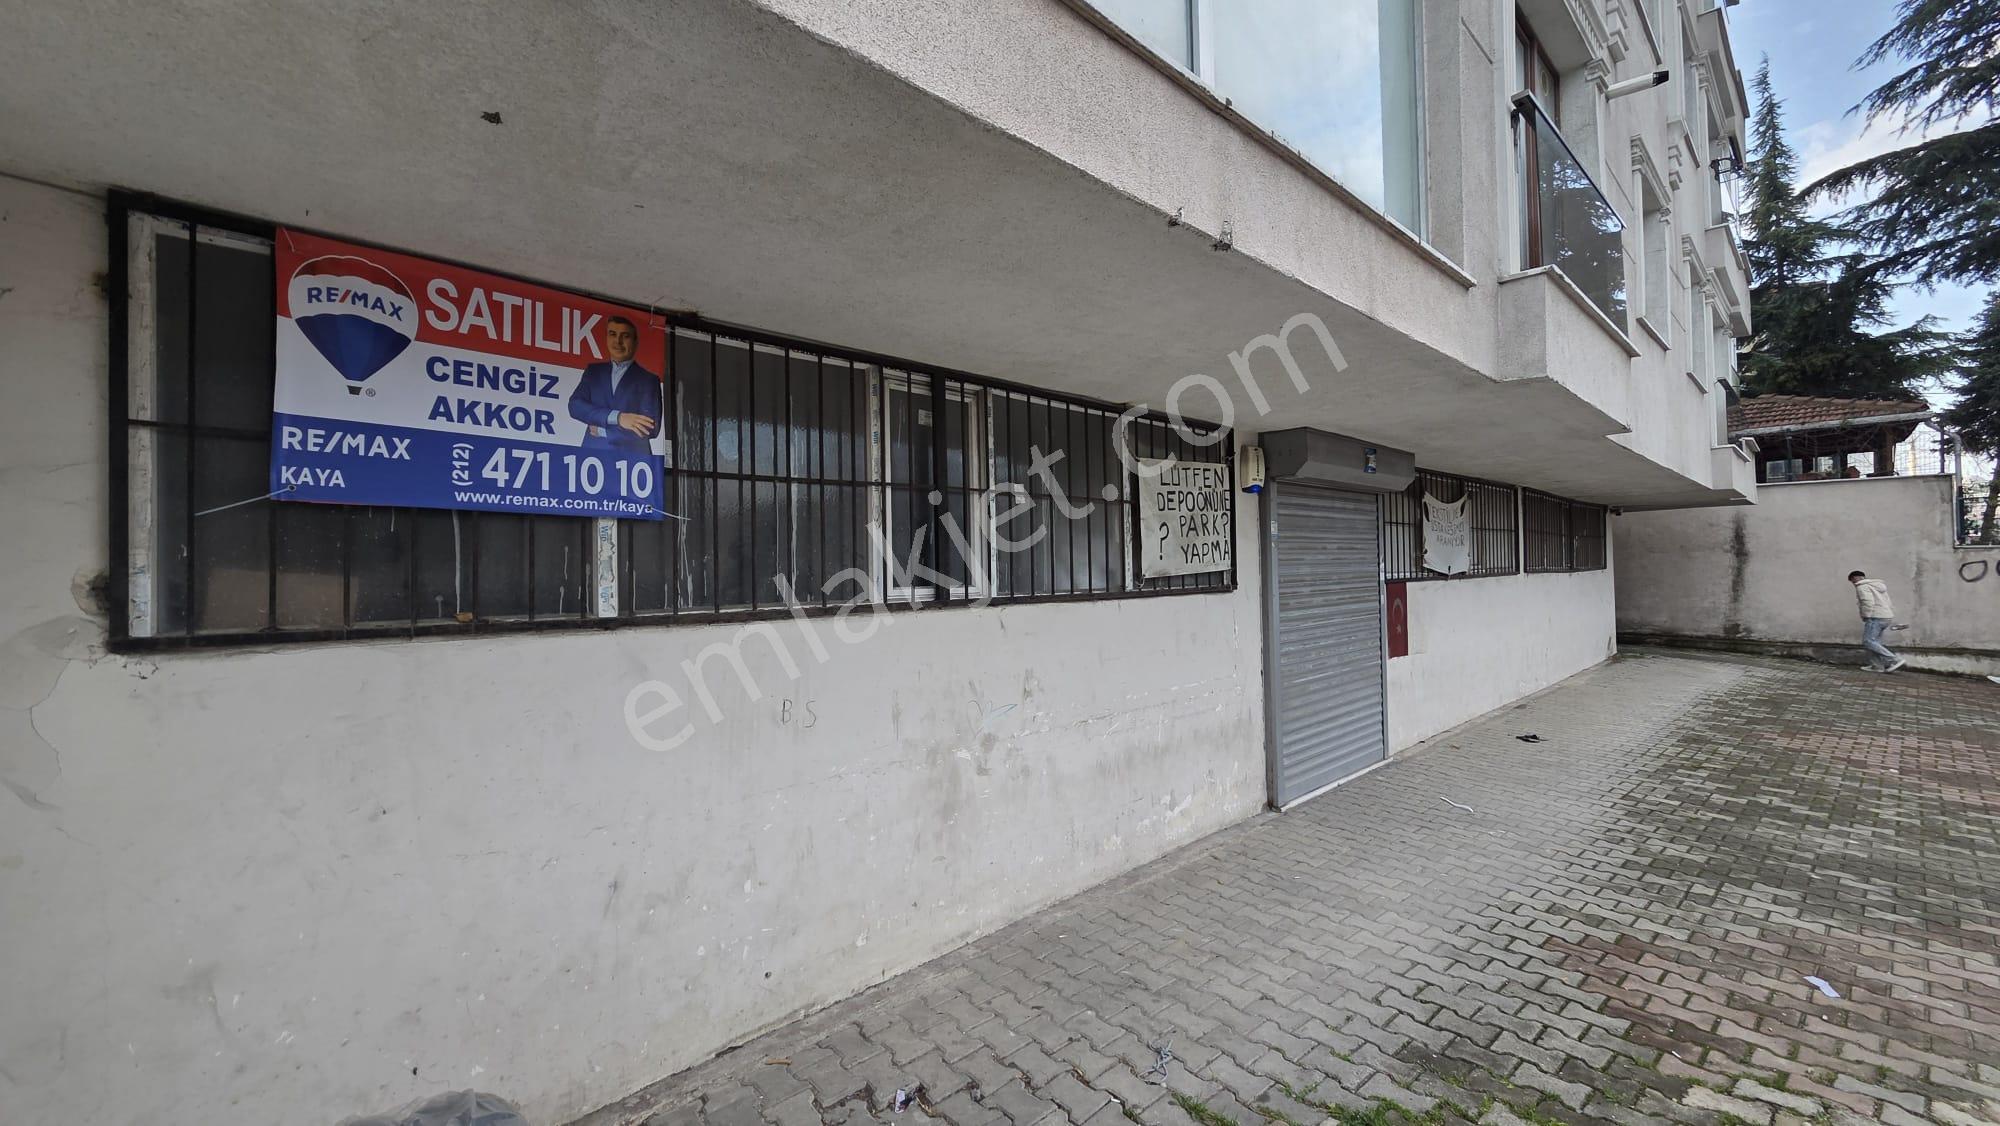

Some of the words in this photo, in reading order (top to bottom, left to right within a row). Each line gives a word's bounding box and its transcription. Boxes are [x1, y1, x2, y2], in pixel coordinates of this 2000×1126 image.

[307, 286, 404, 322] RE/MAX
[425, 278, 604, 360] SATILIK
[426, 356, 560, 400] CENGİZ
[428, 395, 556, 435] AKKOR
[281, 426, 412, 461] RE/MAX
[281, 465, 346, 488] KAYA
[452, 443, 475, 487] (212)
[482, 447, 550, 491] 471
[563, 454, 605, 495] 10
[615, 460, 654, 499] 10
[1160, 465, 1225, 489] LÜTFEN
[454, 491, 654, 516] www.remax.com.tr/kaya
[1180, 539, 1230, 565] YAPMA
